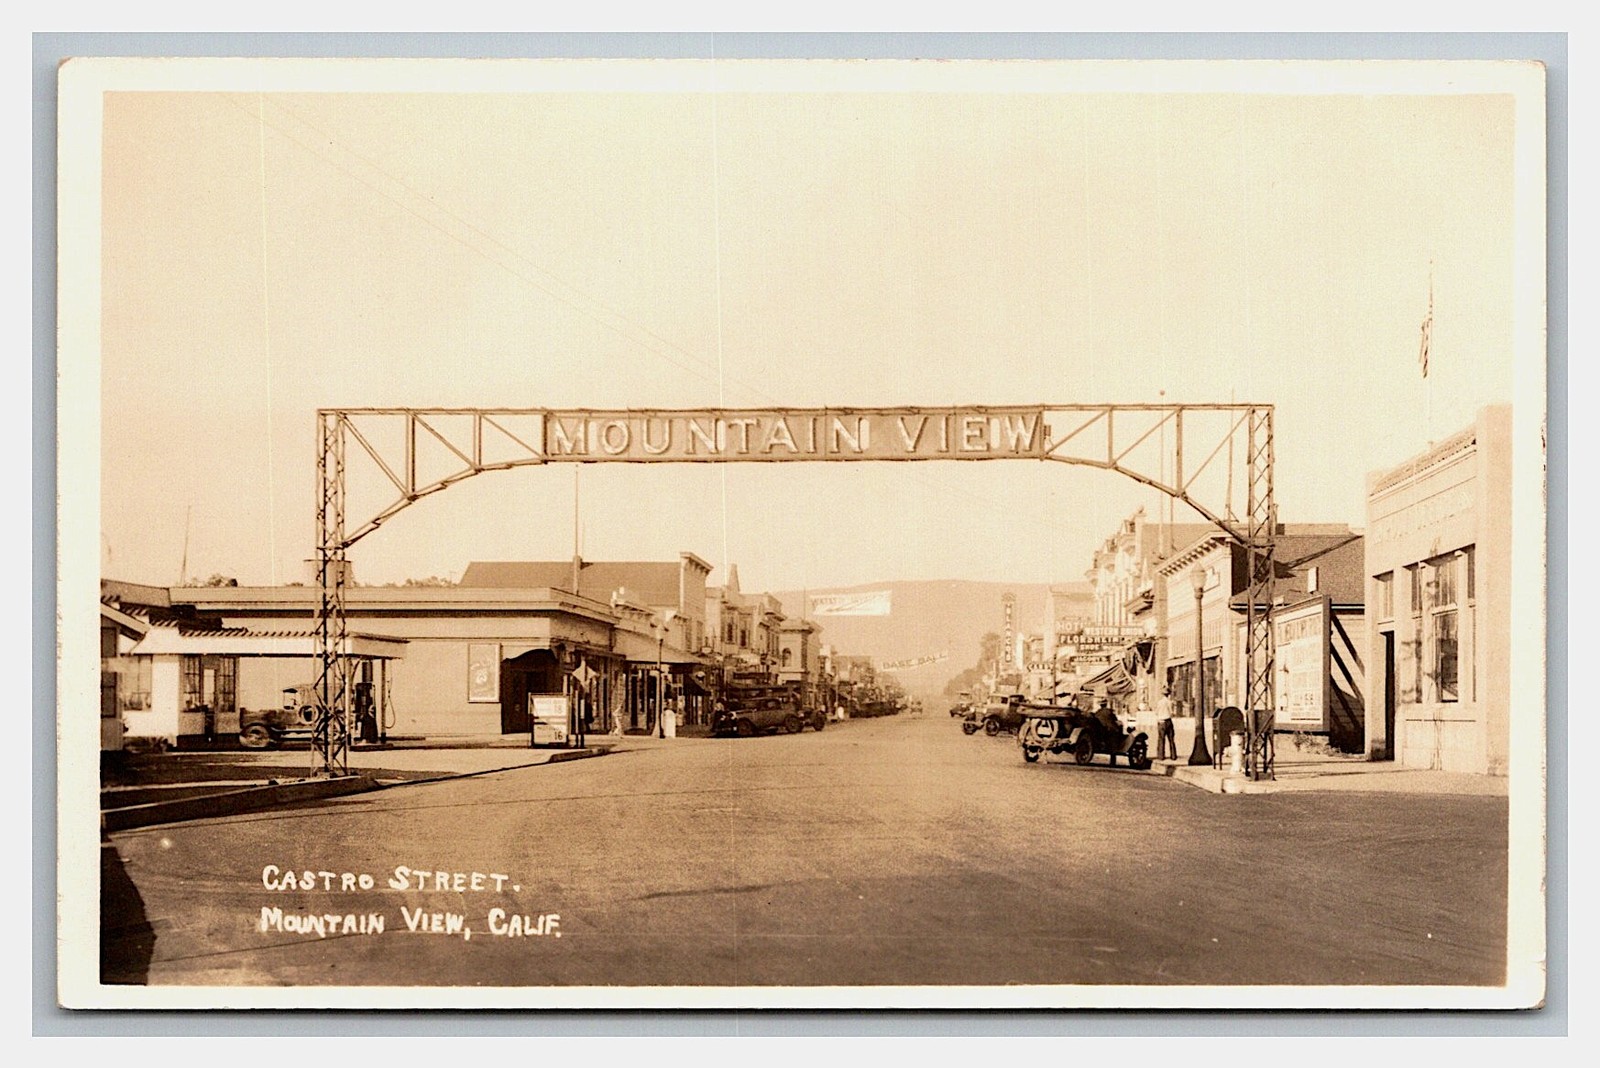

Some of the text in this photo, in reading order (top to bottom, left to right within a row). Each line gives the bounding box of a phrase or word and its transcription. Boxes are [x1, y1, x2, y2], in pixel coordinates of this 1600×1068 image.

[552, 416, 1037, 455] MOUNTAIN VIEW
[882, 653, 947, 670] BASE BALL
[554, 730, 564, 741] 16
